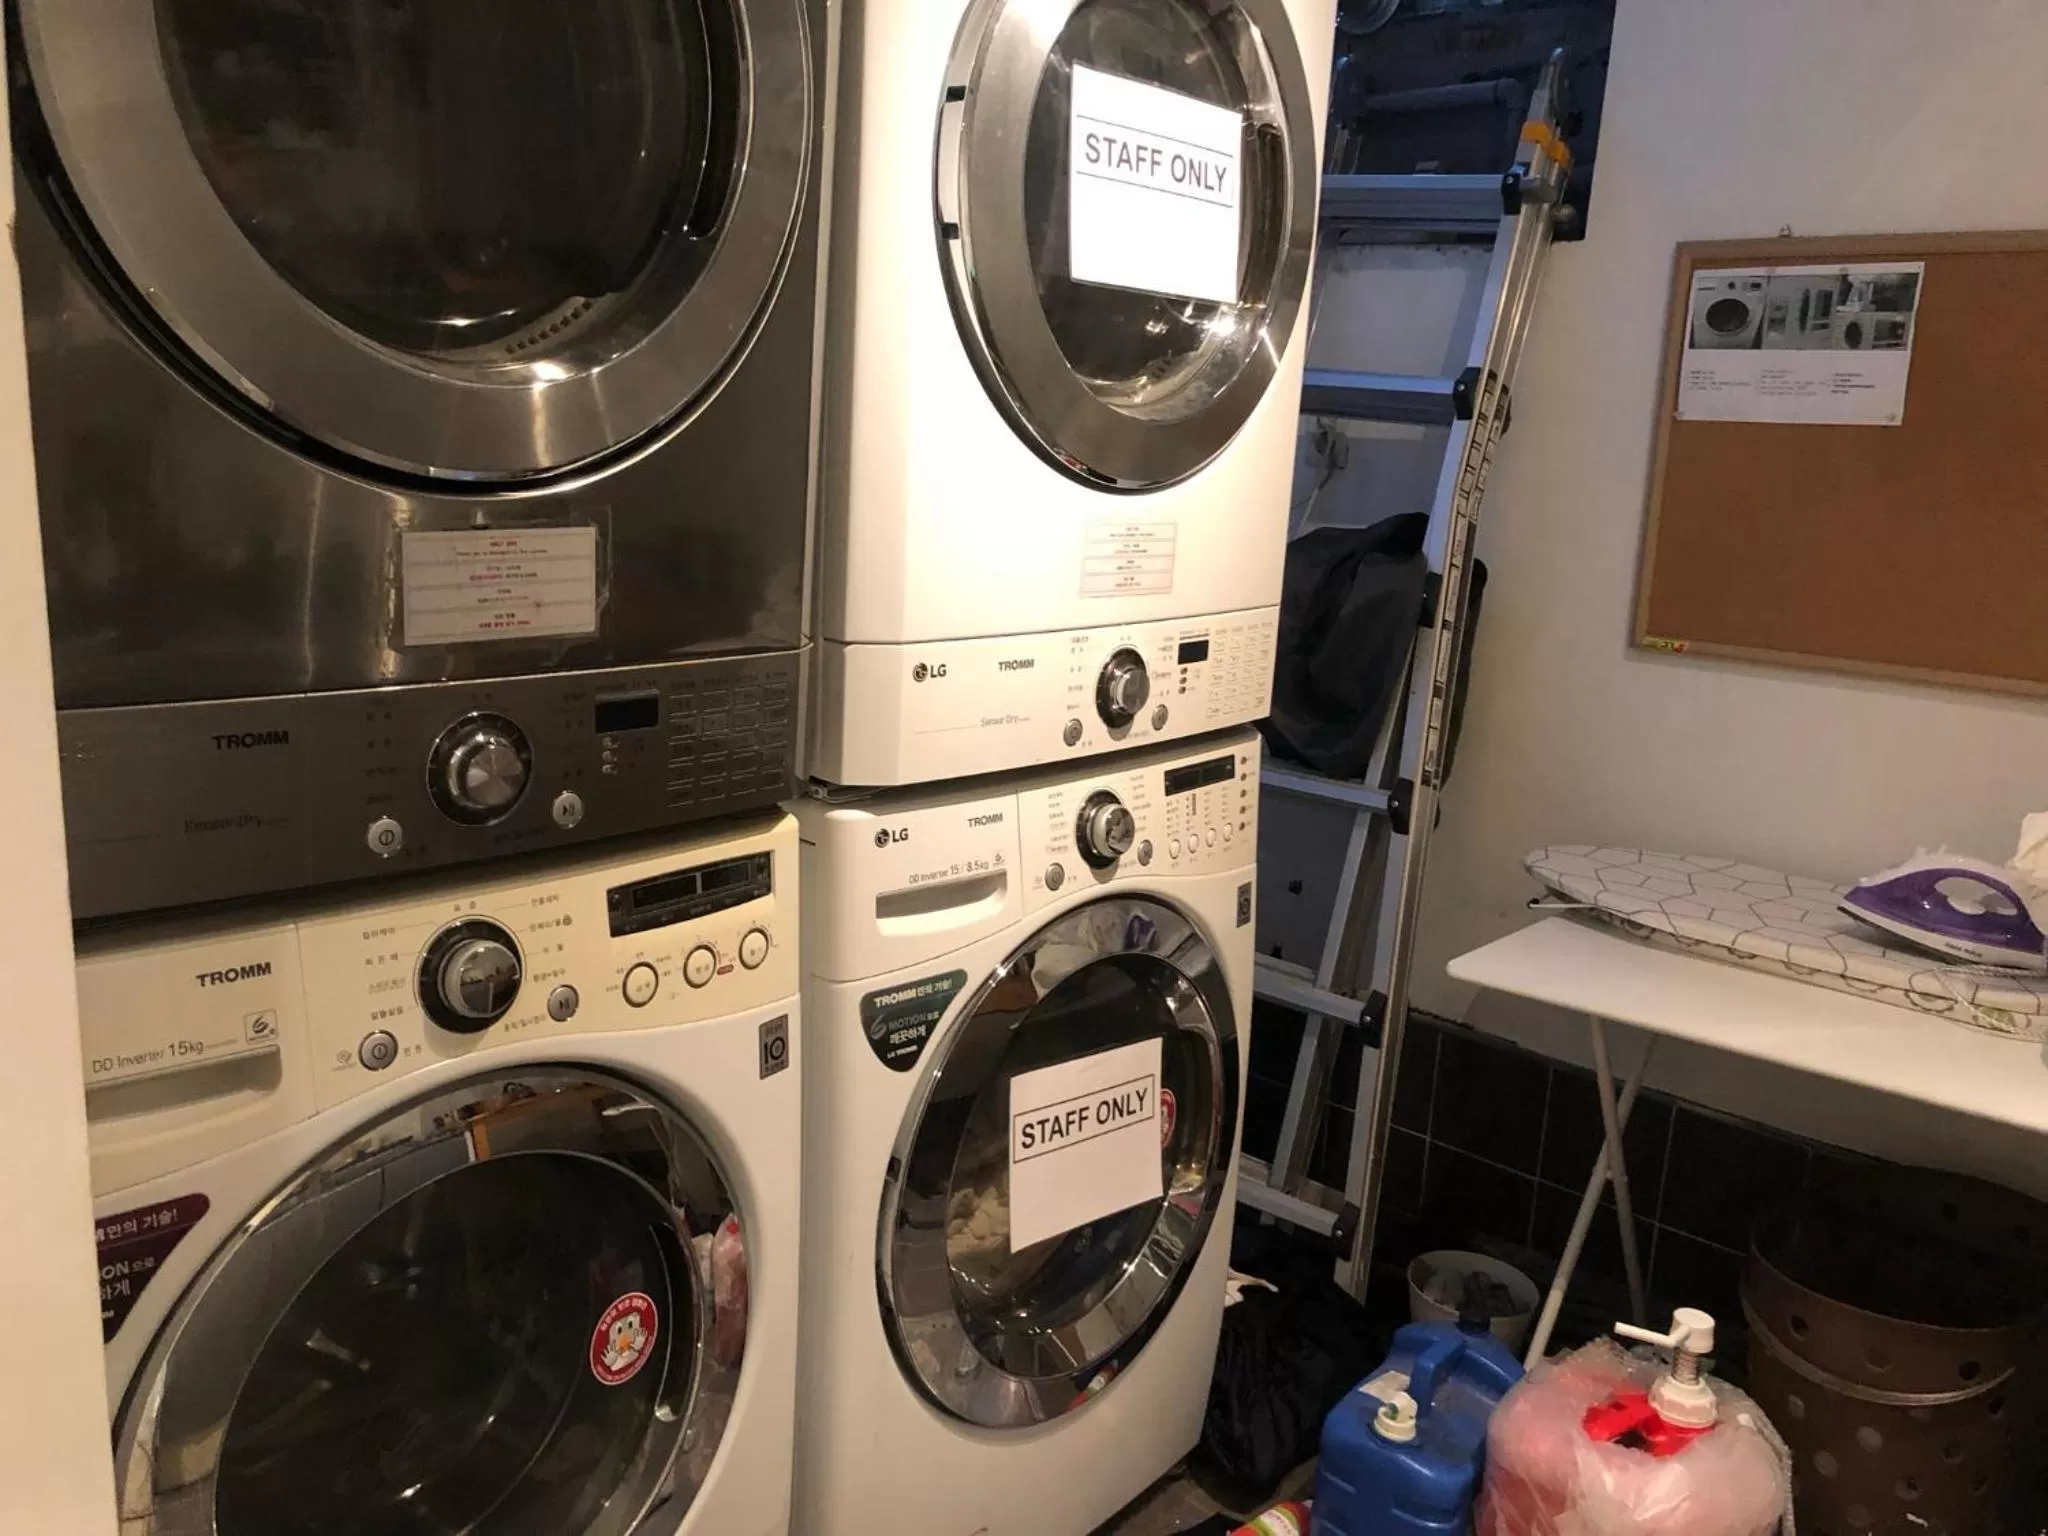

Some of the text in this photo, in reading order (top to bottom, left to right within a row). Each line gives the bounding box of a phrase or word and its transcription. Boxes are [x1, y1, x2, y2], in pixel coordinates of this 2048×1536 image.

[1085, 133, 1227, 193] STAFF ONLY
[997, 658, 1035, 672] TROMM
[211, 730, 290, 750] TROMM
[967, 812, 1003, 828] TROMM
[949, 863, 960, 876] 15
[196, 961, 273, 988] TROMM
[92, 1040, 204, 1074] DD Inverter 15kg
[1020, 1087, 1149, 1150] STAFF ONLY
[142, 1208, 179, 1229] 기술!
